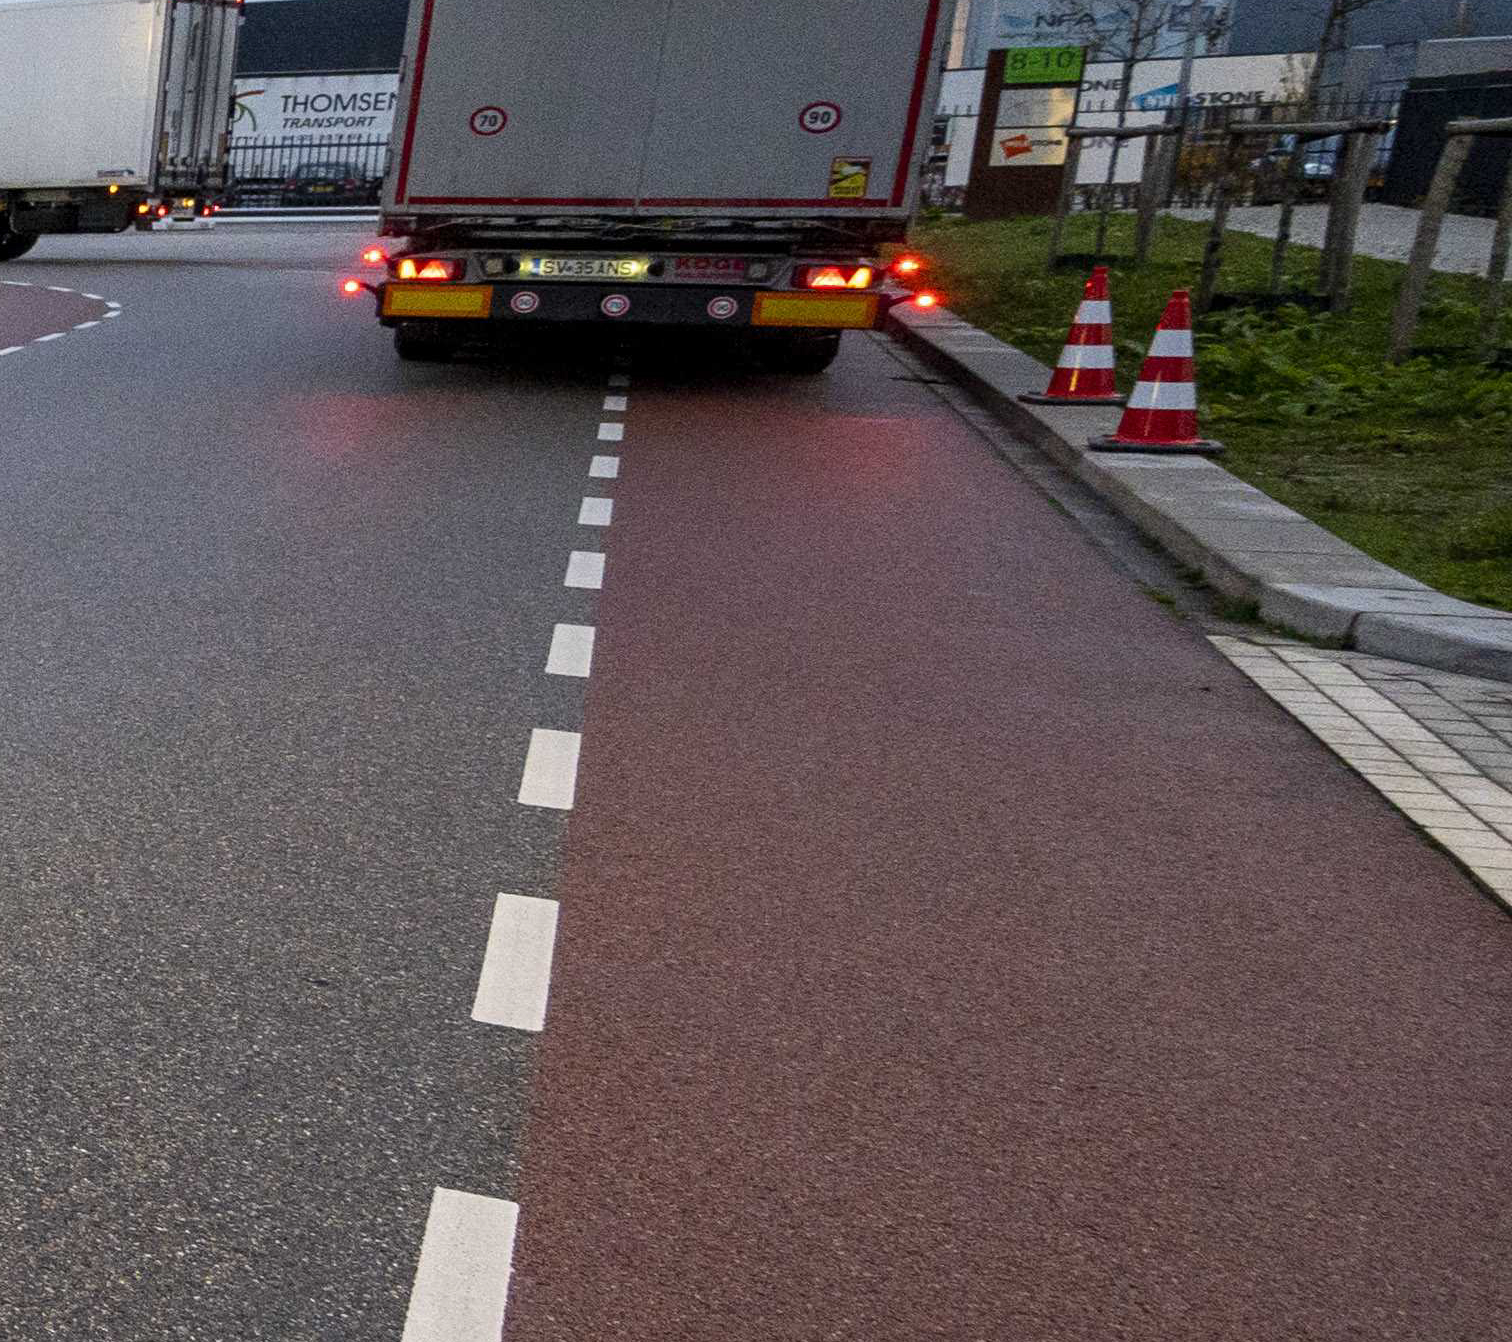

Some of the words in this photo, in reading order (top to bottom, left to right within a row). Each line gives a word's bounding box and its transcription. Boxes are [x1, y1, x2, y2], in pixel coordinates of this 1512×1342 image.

[1011, 50, 1076, 71] 8-10
[282, 115, 377, 130] TRANSPORT
[808, 111, 832, 124] 90
